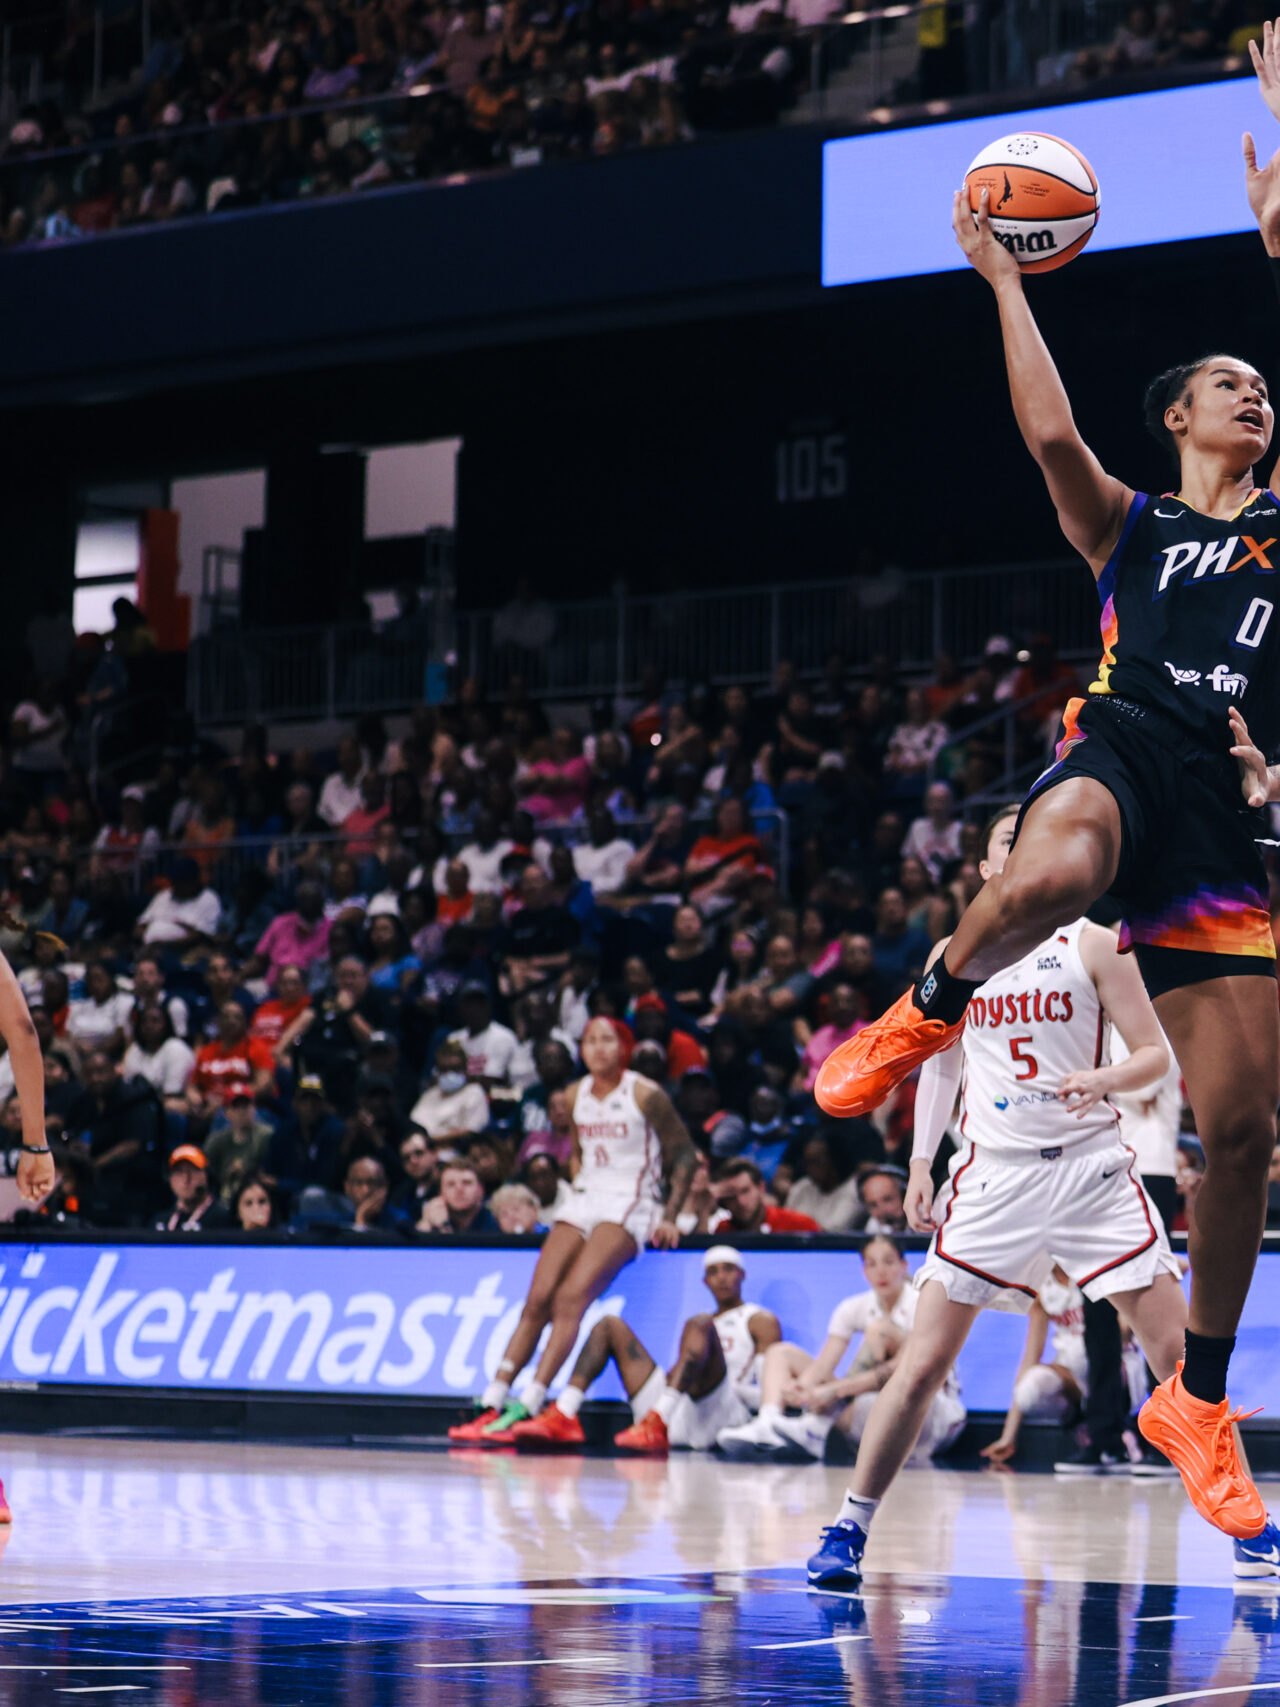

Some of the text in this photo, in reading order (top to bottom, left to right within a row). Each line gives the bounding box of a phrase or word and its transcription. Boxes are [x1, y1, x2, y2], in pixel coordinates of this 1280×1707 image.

[777, 433, 847, 503] 105
[1156, 536, 1278, 593] PHX
[1234, 597, 1275, 648] 0
[1009, 1036, 1039, 1081] 5
[0, 1252, 627, 1389] icketmastr
